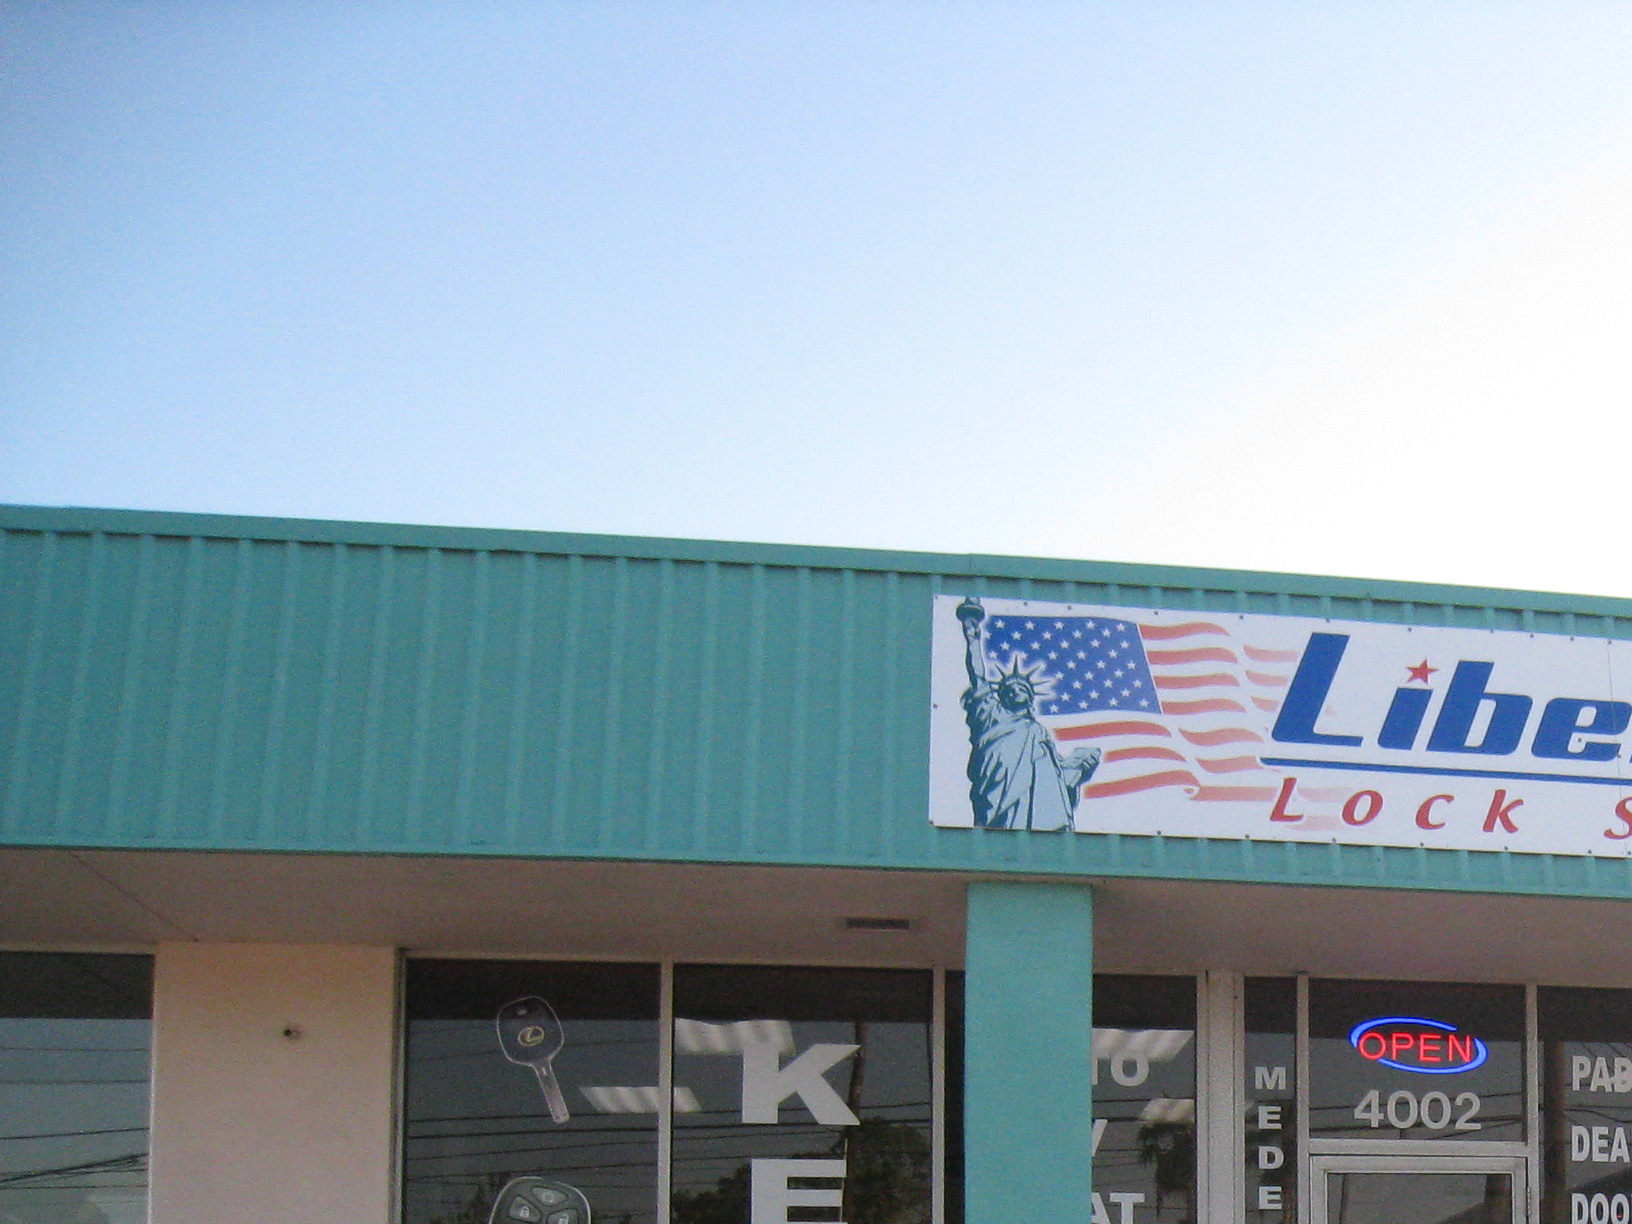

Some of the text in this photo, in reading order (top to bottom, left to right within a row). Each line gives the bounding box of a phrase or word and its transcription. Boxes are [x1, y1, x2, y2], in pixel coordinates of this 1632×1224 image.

[1269, 776, 1525, 836] Lock
[1357, 1031, 1476, 1064] OPEN
[1353, 1089, 1482, 1131] 4002
